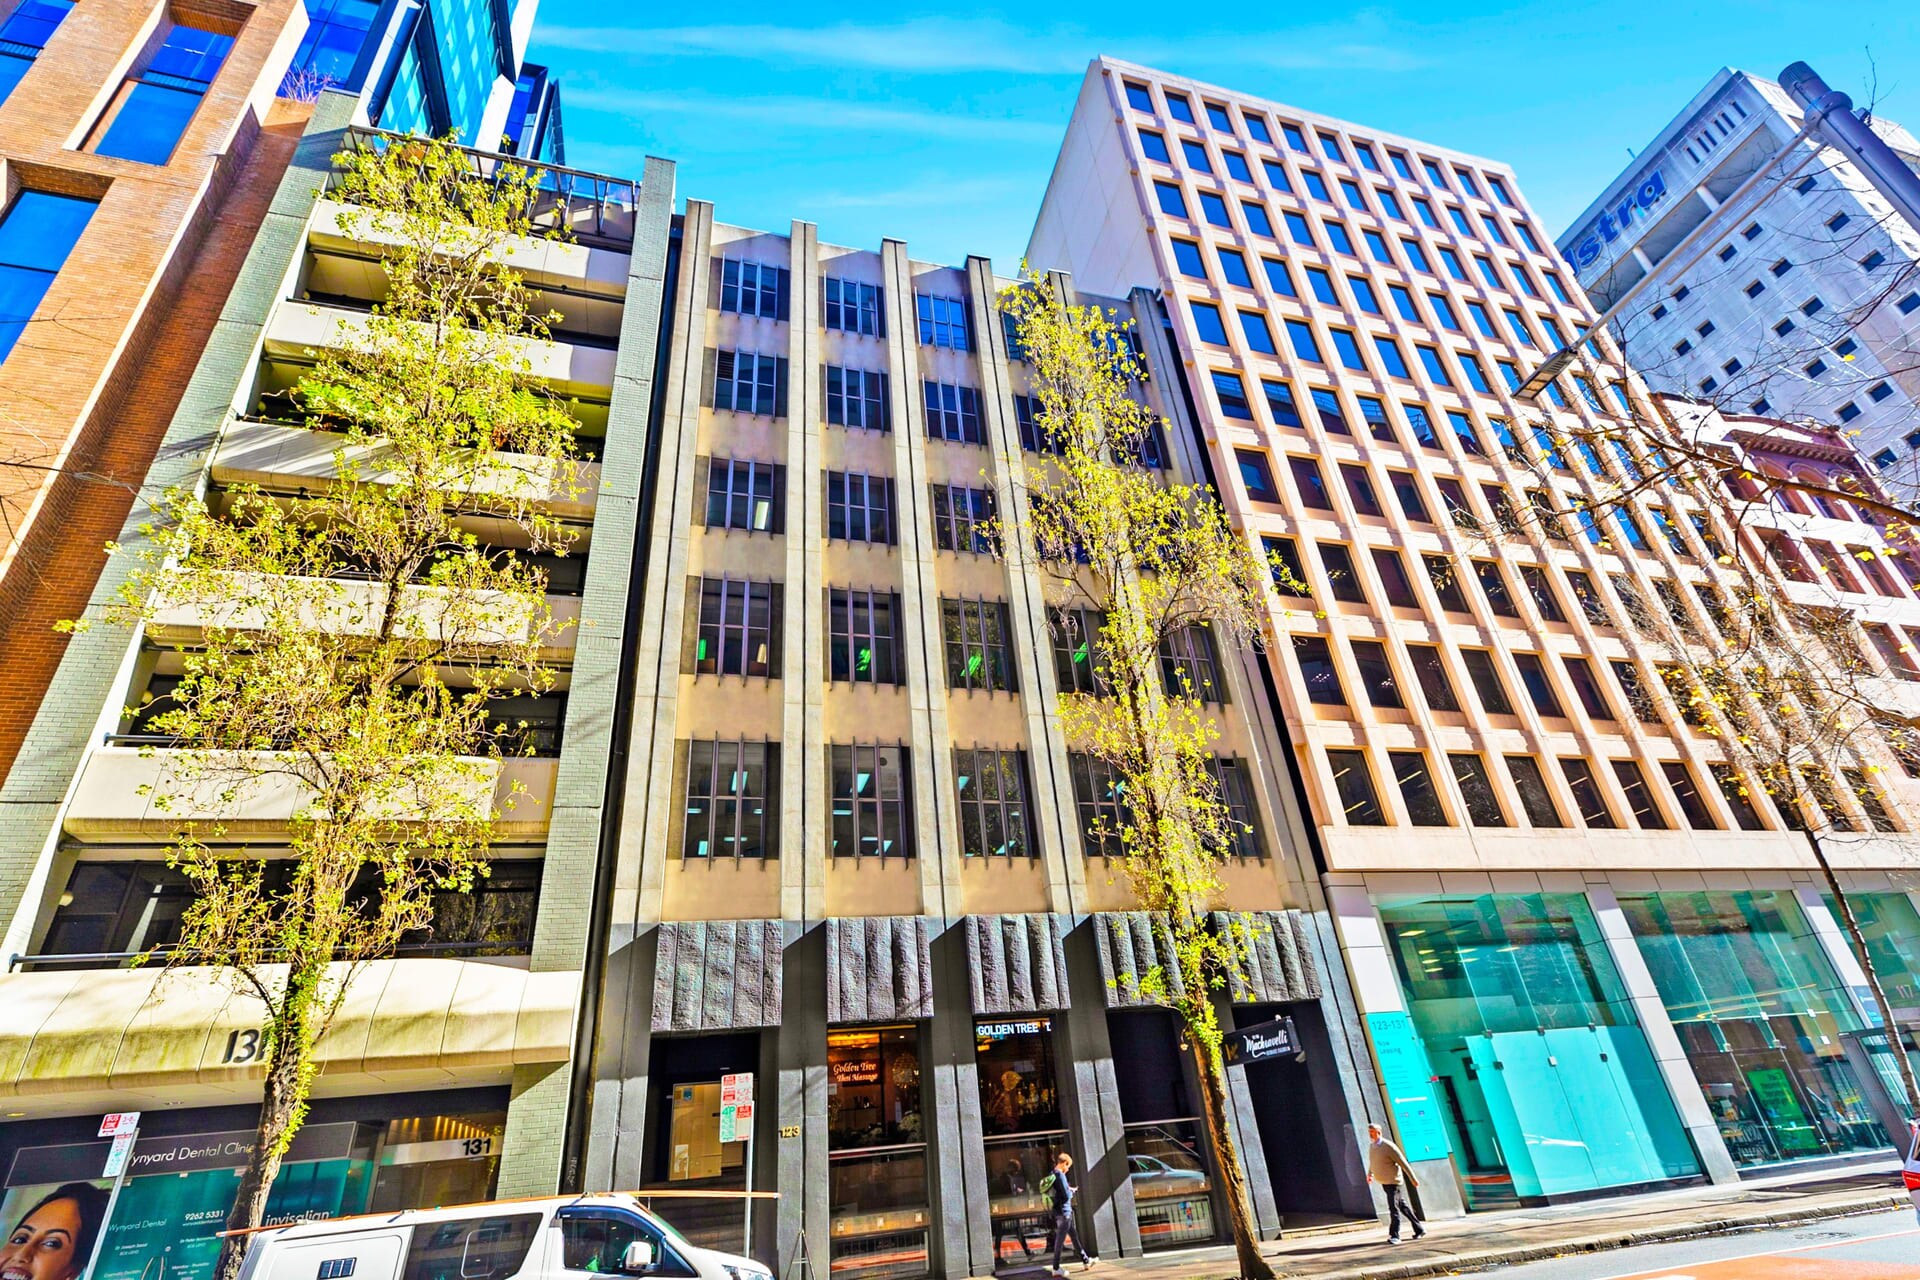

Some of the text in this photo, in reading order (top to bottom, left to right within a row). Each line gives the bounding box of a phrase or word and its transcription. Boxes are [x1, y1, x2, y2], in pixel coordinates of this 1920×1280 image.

[977, 1023, 1014, 1036] GOLDEN
[1014, 1022, 1039, 1034] TREE
[1371, 1019, 1406, 1030] 123-131
[833, 1060, 877, 1075] Golden Tree
[836, 1073, 878, 1083] Thai Massage
[721, 1106, 736, 1115] 4P
[781, 1125, 801, 1137] 123
[178, 1143, 222, 1161] Dental
[462, 1137, 491, 1156] 131
[184, 1210, 224, 1222] 9262 5331
[109, 1218, 168, 1233] Wynyard Dental
